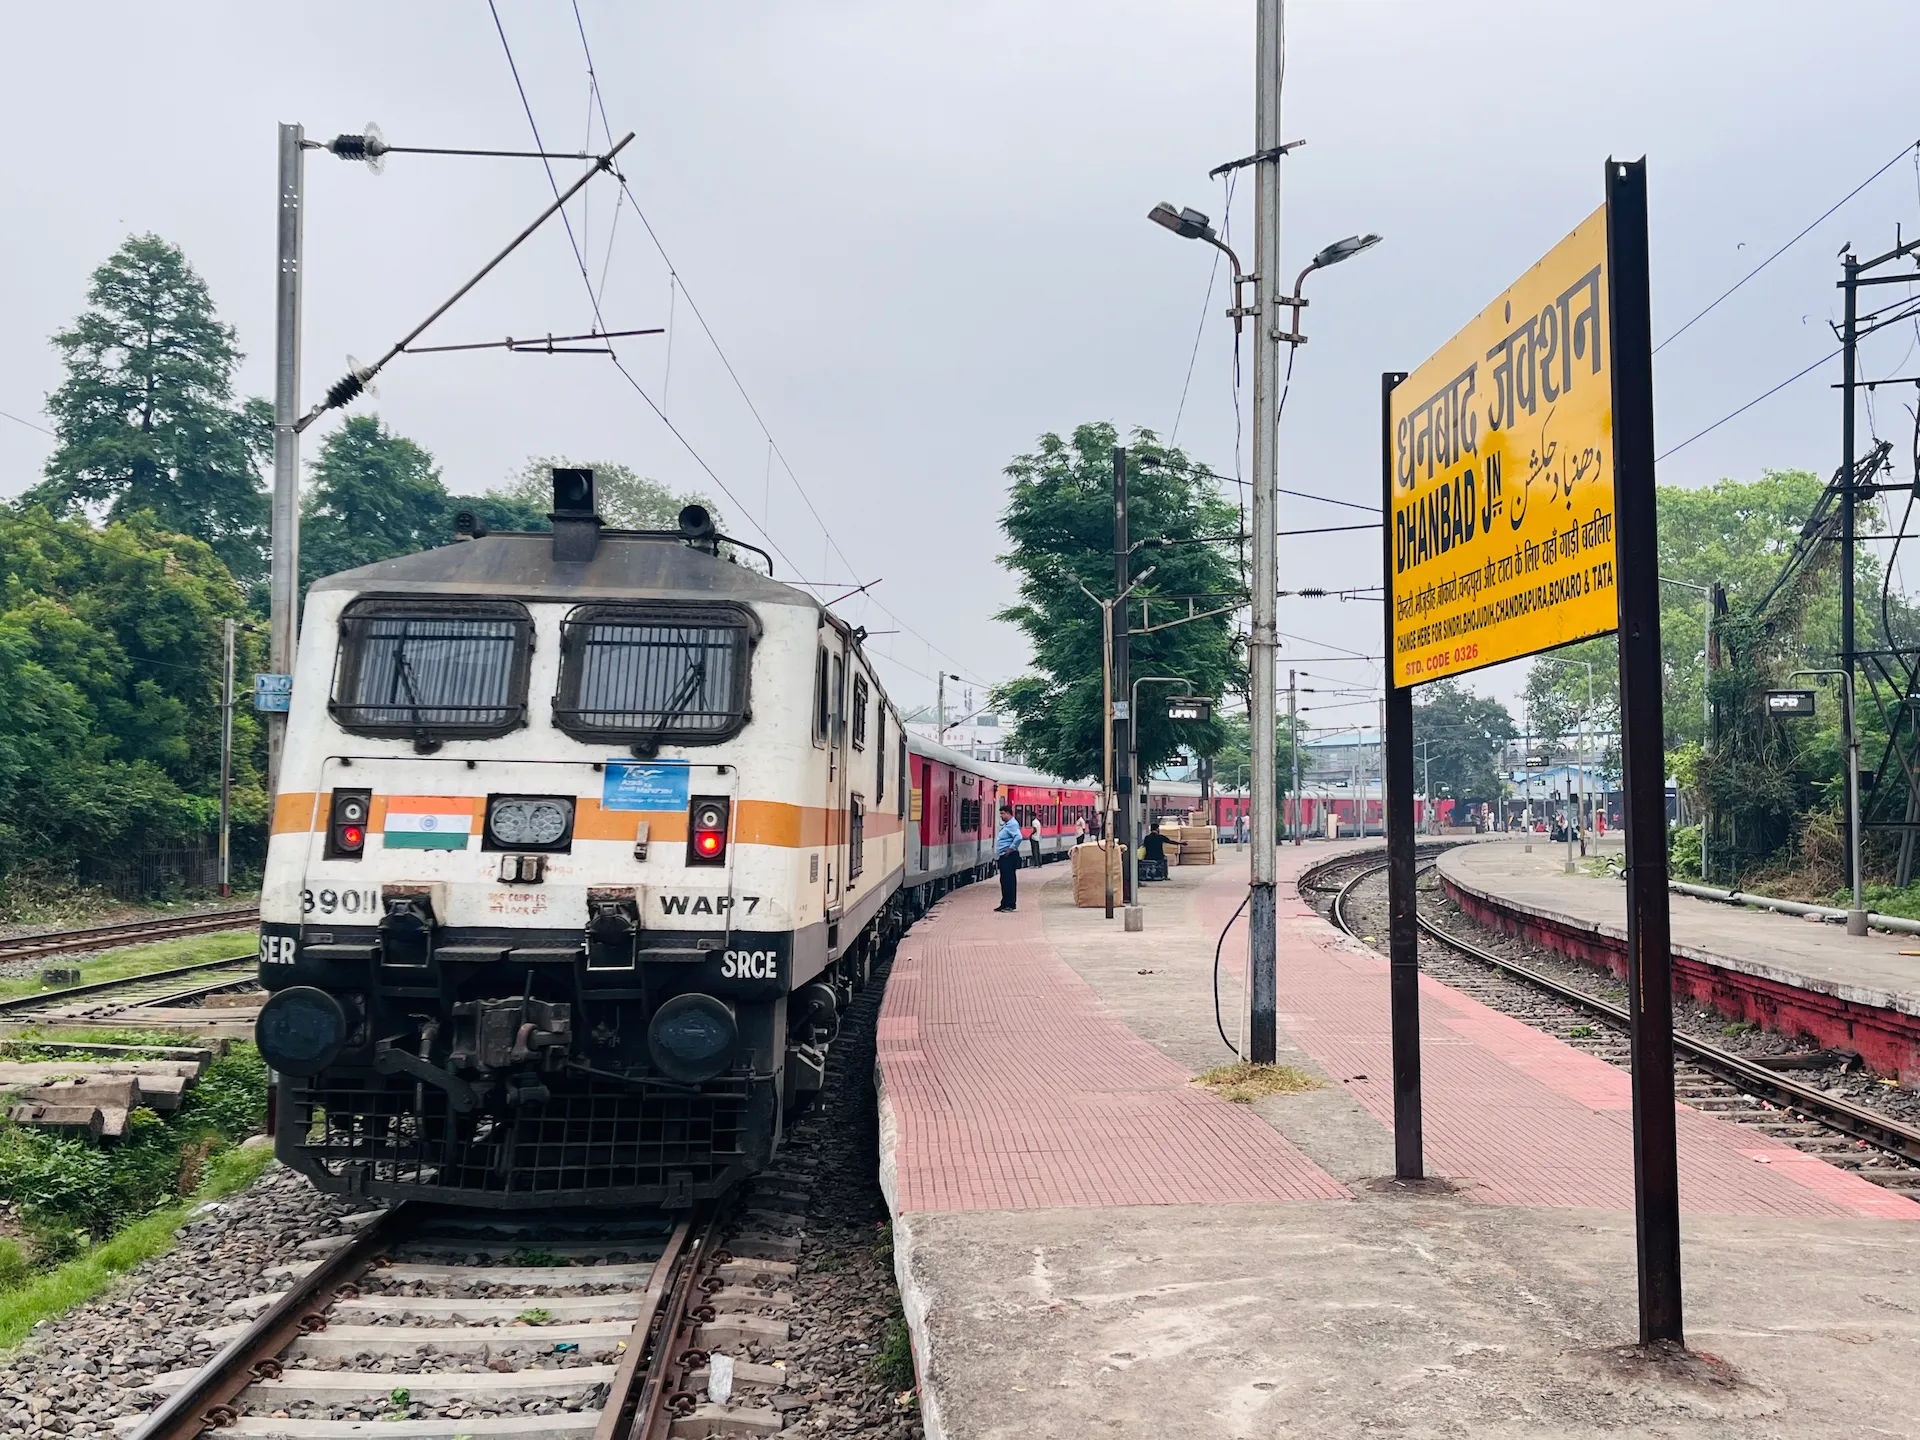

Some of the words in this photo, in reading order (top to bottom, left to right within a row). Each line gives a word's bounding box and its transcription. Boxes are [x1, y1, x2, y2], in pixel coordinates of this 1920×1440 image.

[1397, 361, 1478, 491] धनबाद
[1486, 262, 1602, 432] जंक्शन
[1397, 469, 1476, 575] DHANBAD
[1498, 555, 1513, 583] टाटा
[1514, 544, 1523, 576] के
[1524, 539, 1540, 574] लिए
[1559, 518, 1579, 560] गाड़ी
[1581, 508, 1611, 550] बदलिए
[1397, 631, 1417, 653] CHANGE
[1417, 624, 1431, 648] HERE
[1431, 621, 1443, 644] FOR
[1583, 569, 1590, 594] &
[1592, 560, 1614, 592] TATA
[1405, 660, 1424, 676] STD.
[1426, 651, 1450, 671] CODE
[1454, 644, 1479, 663] 0326
[298, 889, 377, 914] 39011
[260, 935, 296, 965] SER
[721, 951, 777, 979] SRCE
